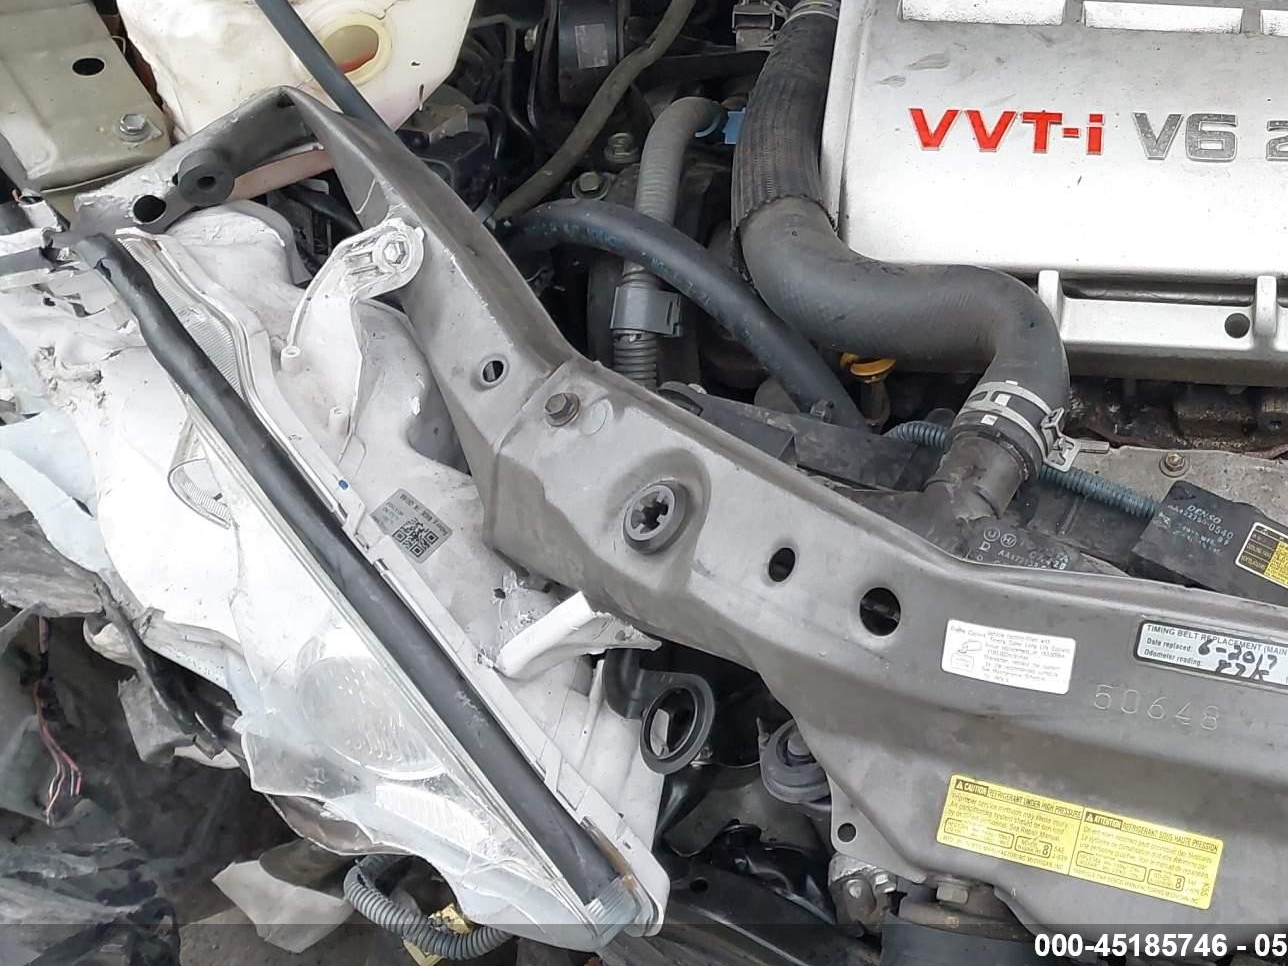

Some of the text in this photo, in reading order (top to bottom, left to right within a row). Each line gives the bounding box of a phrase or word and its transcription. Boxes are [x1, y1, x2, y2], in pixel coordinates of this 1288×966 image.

[909, 109, 1106, 154] VVT-i
[1132, 112, 1238, 164] V6
[1187, 505, 1222, 525] DENSO
[1147, 625, 1175, 636] TIMING
[1177, 630, 1198, 640] BELT
[1146, 637, 1162, 646] Date
[1144, 648, 1175, 661] Odometer
[1093, 683, 1221, 731] 50648
[964, 782, 987, 795] CAUTION
[1043, 845, 1048, 855] 8
[1176, 878, 1181, 888] 8
